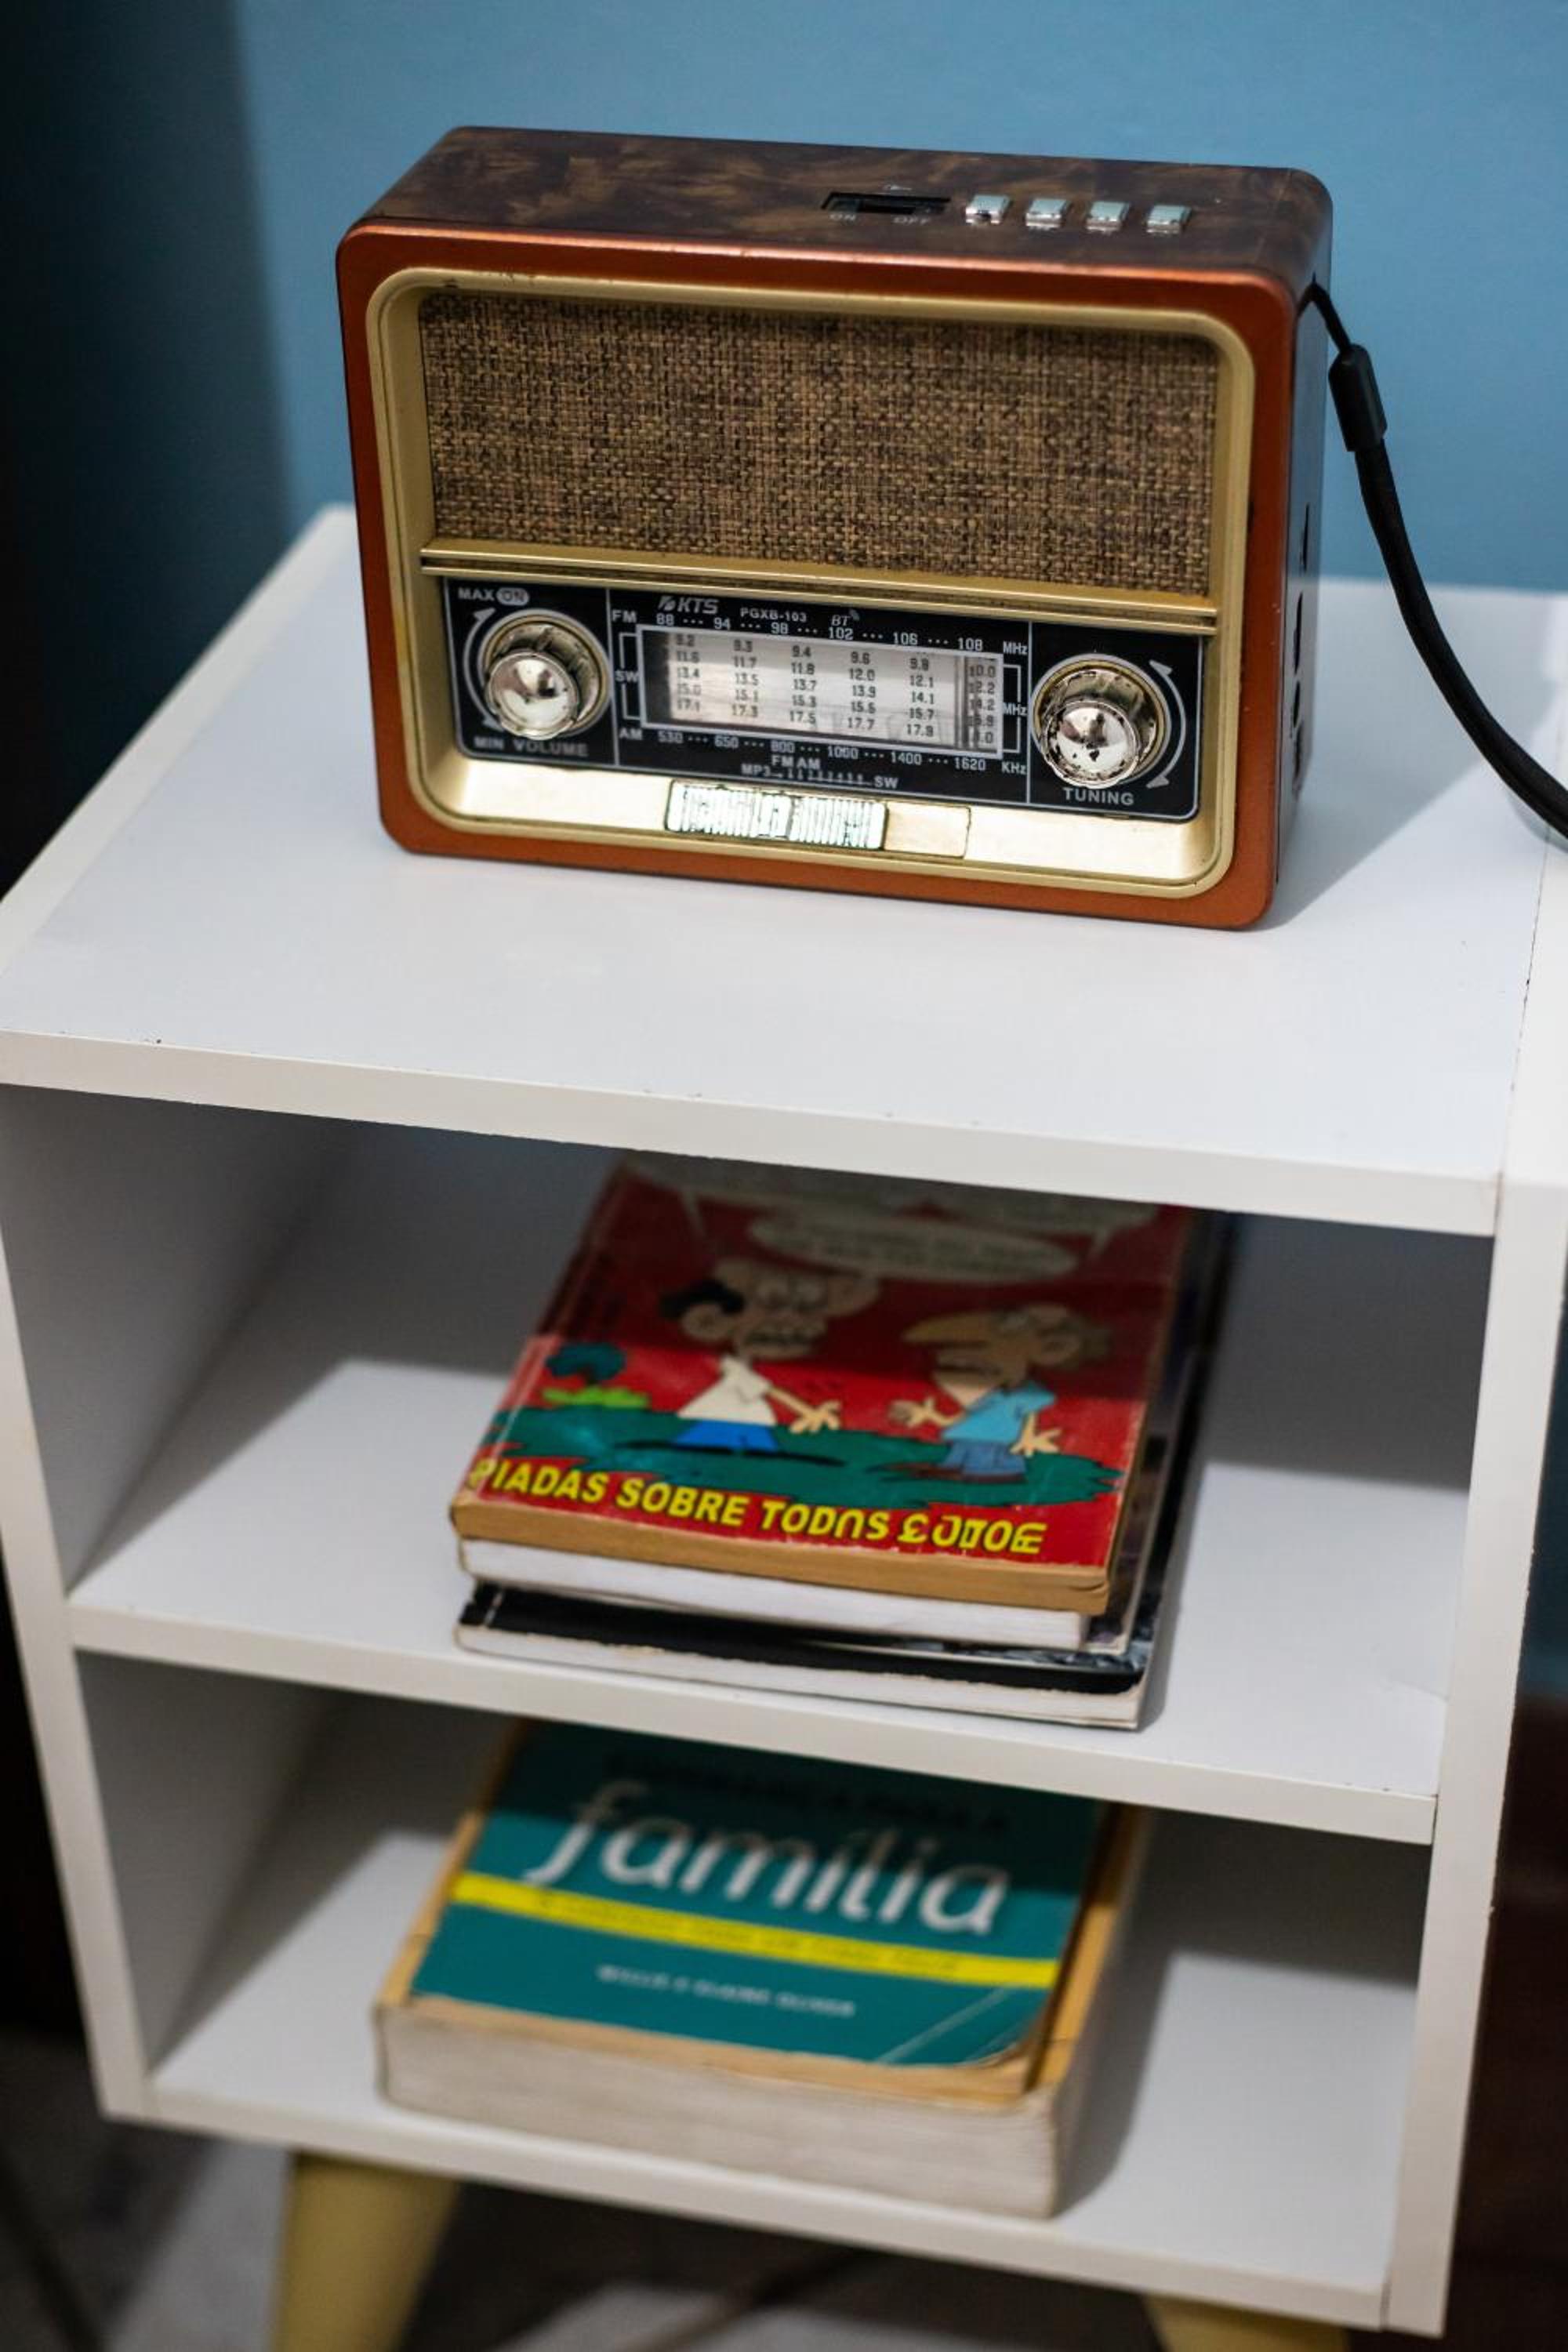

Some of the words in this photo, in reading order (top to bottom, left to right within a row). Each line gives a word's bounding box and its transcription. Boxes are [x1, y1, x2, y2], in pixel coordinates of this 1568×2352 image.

[458, 587, 495, 601] MAX
[503, 590, 524, 604] ON
[677, 597, 719, 615] KTS
[831, 614, 852, 626] BT
[612, 609, 637, 623] FM
[655, 612, 675, 626] 88
[713, 616, 731, 630] 94
[771, 622, 789, 634] 98
[829, 626, 854, 641] 102
[957, 637, 983, 652] 108
[1004, 641, 1028, 655] MHz
[792, 644, 811, 658] 9.4
[851, 652, 870, 666] 9.6
[615, 669, 637, 682] SW
[734, 655, 758, 669] 11.7
[791, 662, 815, 676] 11.8
[849, 669, 875, 682] 12.0
[909, 674, 934, 689] 12.1
[736, 672, 760, 686] 13.5
[793, 679, 817, 691] 13.7
[852, 685, 877, 699] 13.9
[910, 691, 935, 706] 14.1
[737, 688, 759, 702] 15.1
[792, 695, 817, 707] 15.3
[909, 706, 935, 720] 15.7
[1004, 702, 1027, 717] MHz
[731, 705, 758, 719] 17.3
[789, 710, 816, 724] 17.5
[848, 717, 876, 730] 17.7
[906, 724, 934, 738] 17.9
[474, 735, 505, 750] MIN
[514, 739, 587, 757] VOLUME
[619, 727, 643, 741] AM
[891, 750, 922, 765] 1400
[955, 757, 987, 771] 1620
[1002, 760, 1027, 775] KHz
[741, 763, 771, 777] MP3
[771, 754, 794, 768] FM
[797, 757, 821, 770] AM
[873, 775, 899, 789] SW
[1063, 786, 1135, 806] TUNING
[468, 1458, 610, 1505] PIADAS
[617, 1475, 746, 1528] SOBRE
